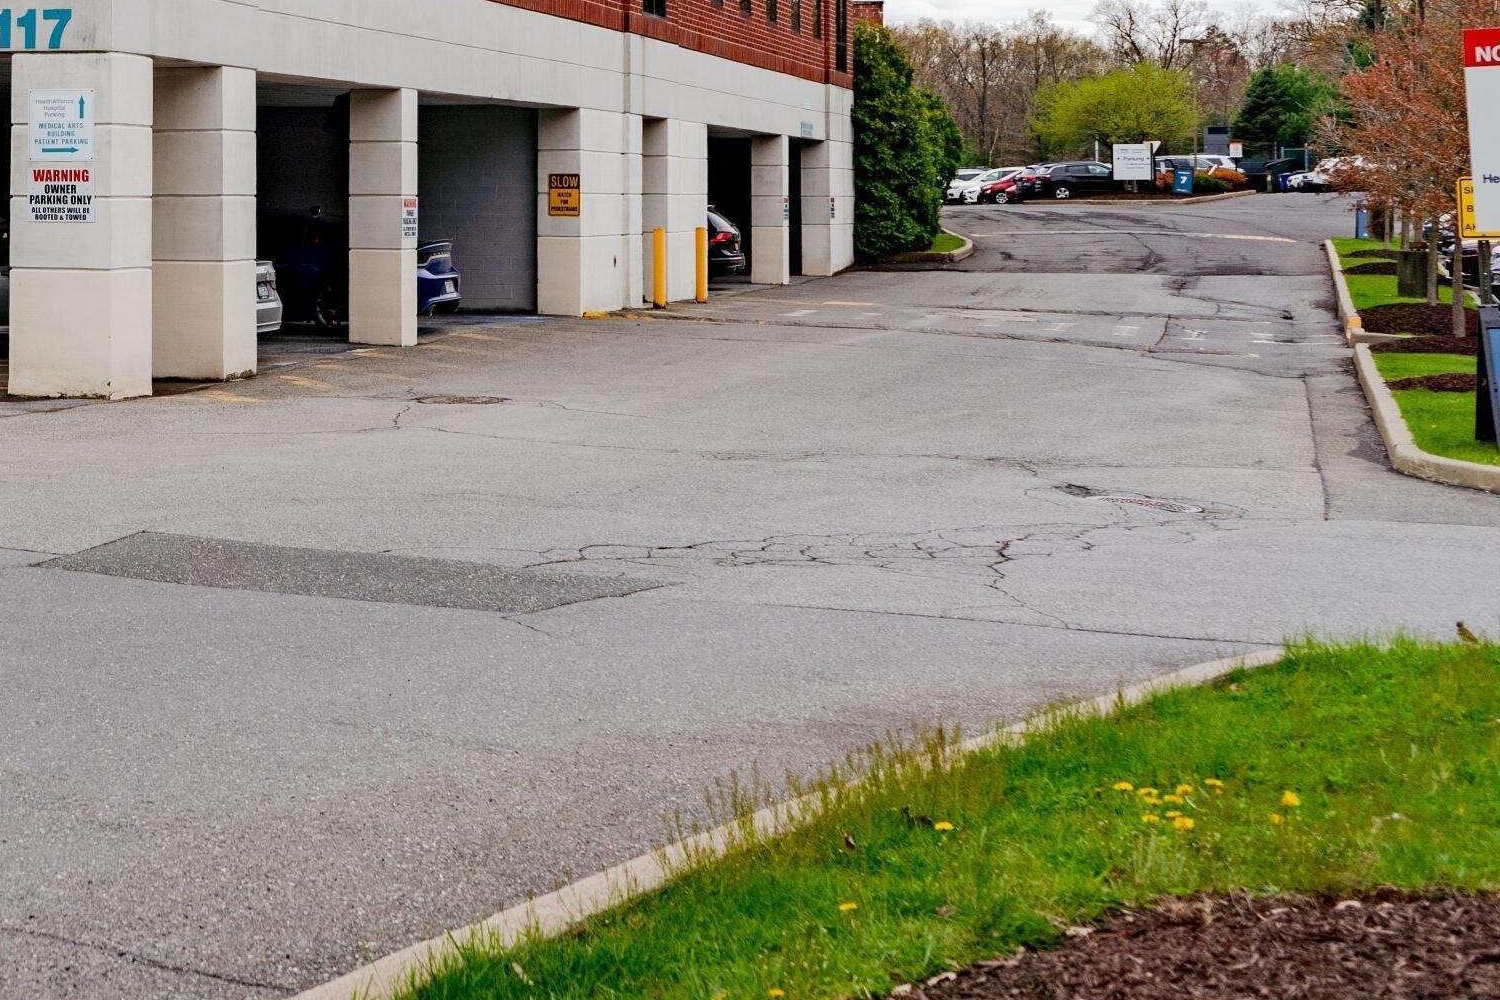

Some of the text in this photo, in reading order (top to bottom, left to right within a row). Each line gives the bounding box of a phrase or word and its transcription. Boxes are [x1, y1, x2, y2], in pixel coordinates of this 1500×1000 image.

[33, 169, 90, 182] WARNING
[1180, 176, 1188, 184] 7
[550, 175, 579, 188] SLOW
[44, 184, 77, 194] OWNER
[29, 194, 92, 205] PARKING ONLY
[31, 206, 42, 214] ALL
[42, 206, 66, 214] OTHERS
[65, 213, 87, 221] TOWED
